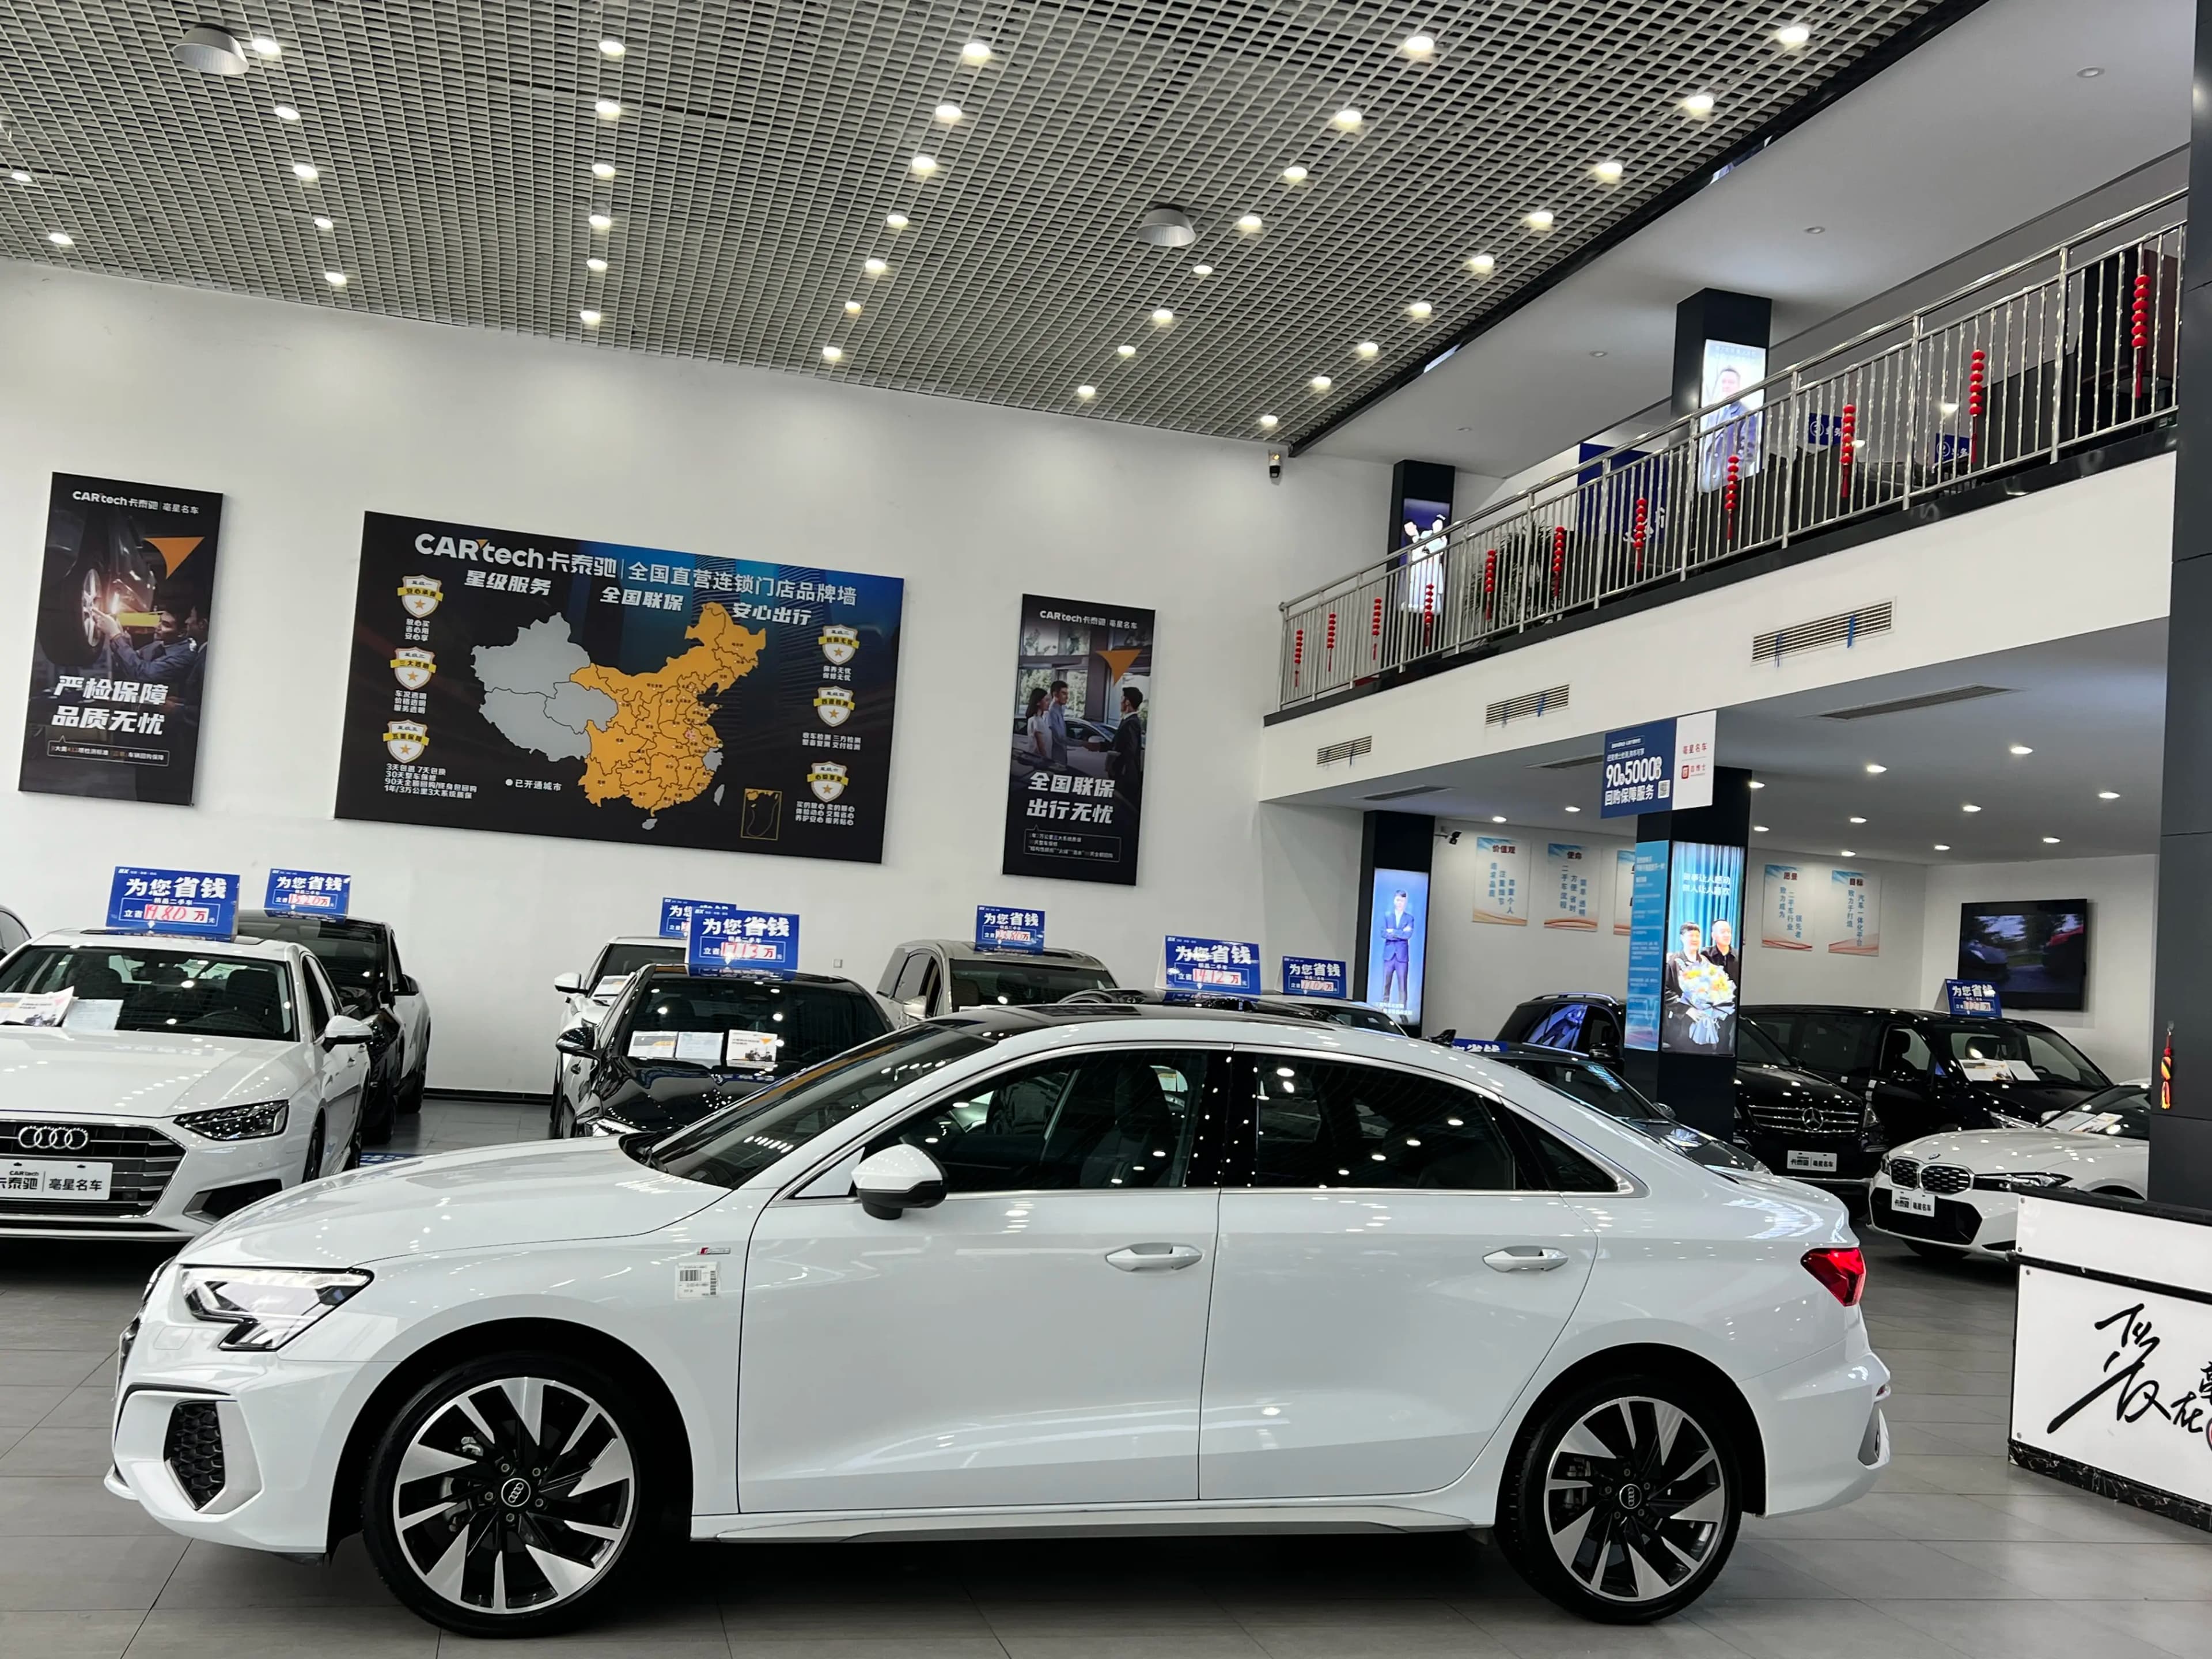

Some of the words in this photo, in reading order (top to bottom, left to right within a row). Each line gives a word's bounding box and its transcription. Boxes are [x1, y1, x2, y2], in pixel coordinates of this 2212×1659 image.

[72, 491, 127, 506] CARtech
[415, 533, 544, 569] CARtech
[547, 551, 617, 578] 卡泰驰
[628, 561, 857, 606] 全国直营连锁门店品牌墙
[464, 570, 551, 596] 星级服务
[600, 586, 684, 612] 全国联保
[732, 602, 812, 626] 安心出行
[54, 675, 169, 705] 严检保障
[51, 705, 165, 735] 品质无忧
[515, 779, 562, 791] 已开通城市
[1028, 771, 1115, 798] 全国联保
[1027, 798, 1113, 824] 出行无忧
[124, 877, 226, 899] 为您省钱
[276, 876, 342, 891] 为您省钱
[194, 910, 207, 921] 万
[984, 912, 1039, 926] 为您省钱
[702, 916, 790, 937] 为您省钱
[763, 948, 774, 957] 万
[1175, 945, 1251, 964] 为您省钱
[1230, 975, 1239, 984] 万
[1289, 963, 1340, 977] 为您省钱
